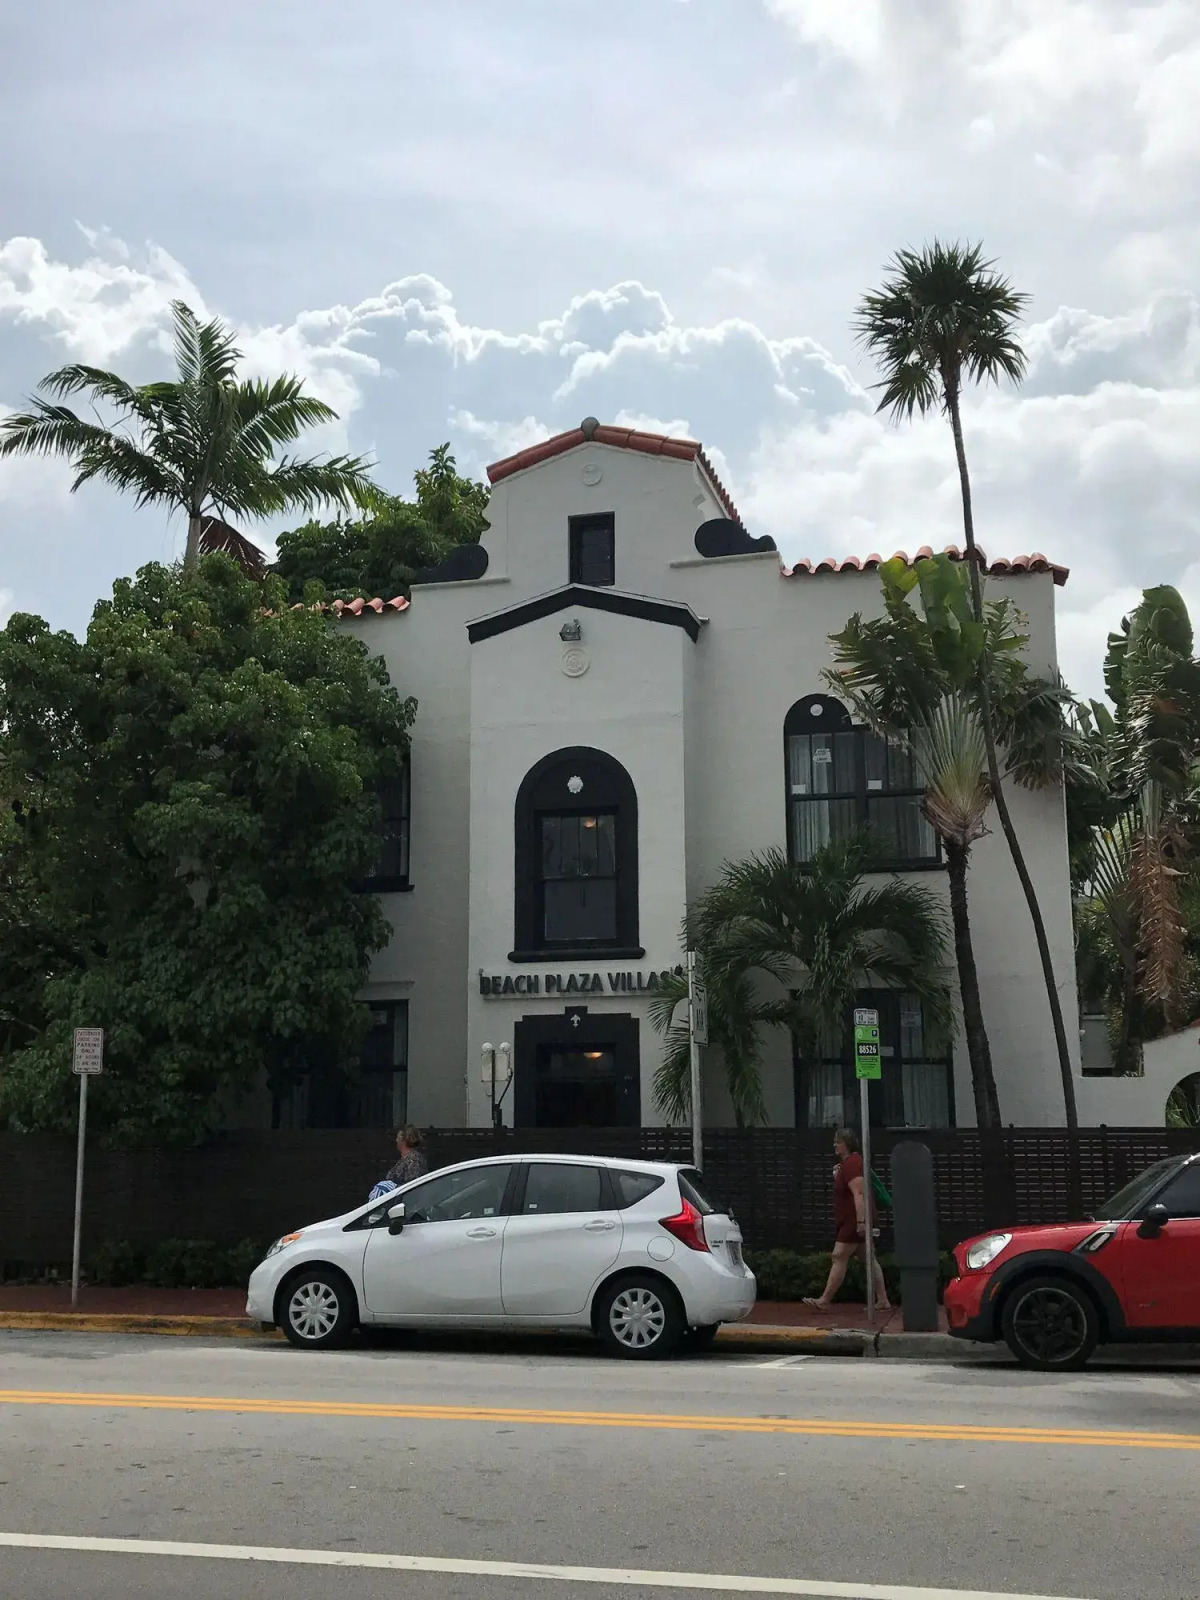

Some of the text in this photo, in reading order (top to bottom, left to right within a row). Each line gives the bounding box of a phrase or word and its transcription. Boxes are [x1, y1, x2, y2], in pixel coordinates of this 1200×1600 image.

[479, 974, 539, 995] BEACH
[545, 973, 604, 993] PLAZA
[859, 1045, 877, 1054] 88526
